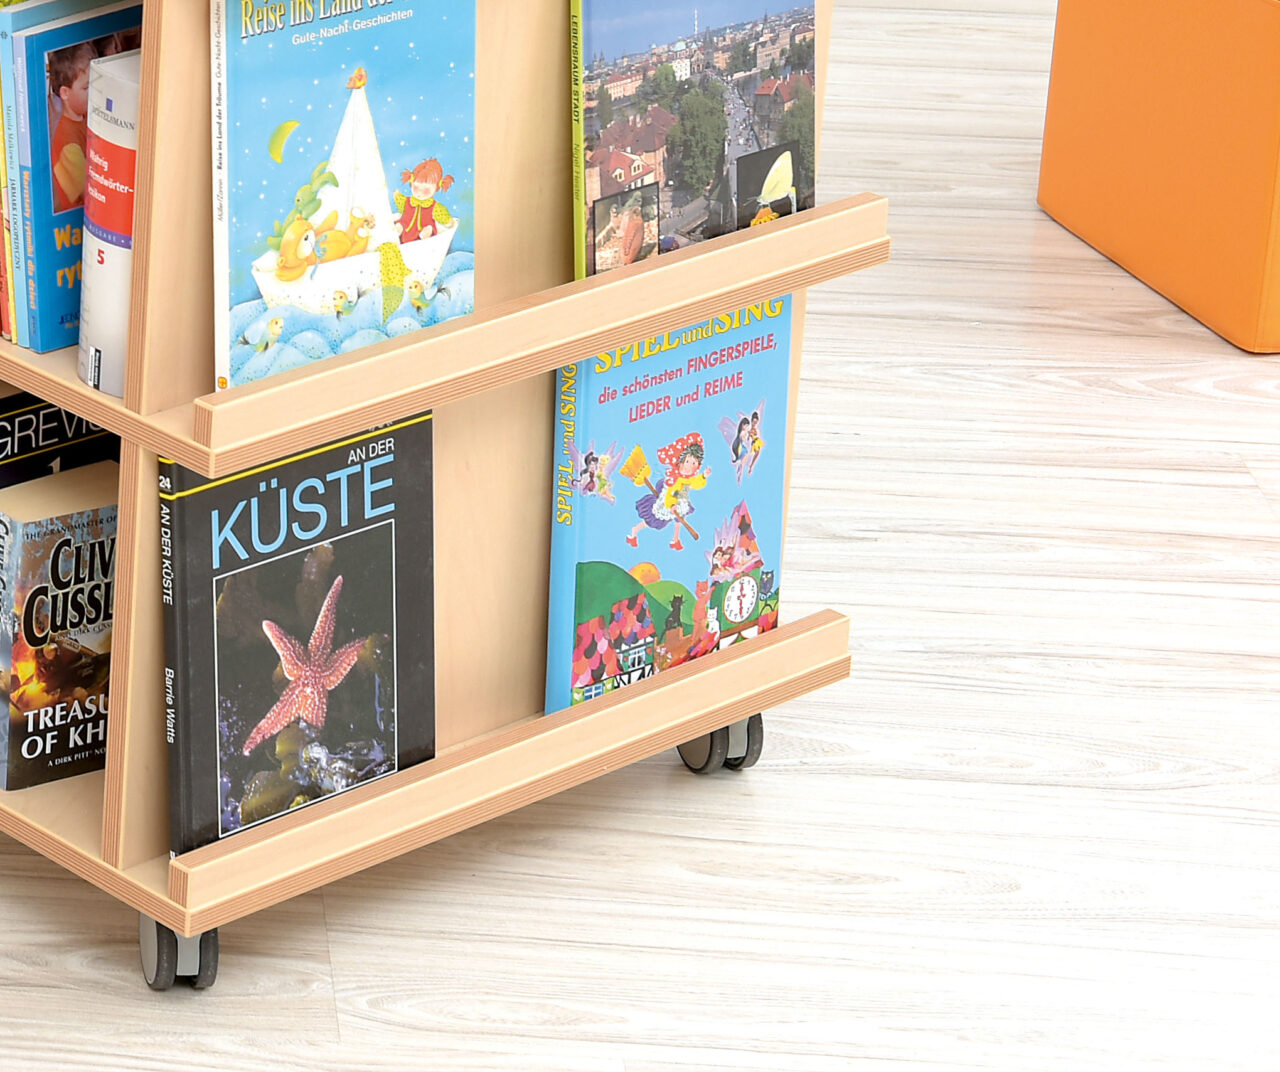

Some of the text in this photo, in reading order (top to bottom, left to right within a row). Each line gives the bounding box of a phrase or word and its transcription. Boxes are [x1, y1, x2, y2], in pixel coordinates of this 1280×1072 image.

[292, 8, 414, 46] Gute-Nacht-Geschichten
[571, 14, 579, 87] LEBENSRAUM
[572, 89, 580, 125] STADT
[27, 259, 35, 276] dla
[96, 248, 106, 266] 5
[682, 319, 714, 346] und
[597, 333, 778, 404] die schönsten FINGERSPIELE,
[560, 363, 577, 417] SING
[628, 371, 744, 424] LIEDER und REIME
[347, 437, 395, 465] AN DER
[158, 475, 172, 490] 24
[211, 453, 396, 570] KÜSTE
[160, 503, 174, 606] AN DER KÜSTE
[164, 667, 176, 744] Barrie Watts
[21, 719, 105, 759] OF KH
[55, 755, 72, 765] DIRK
